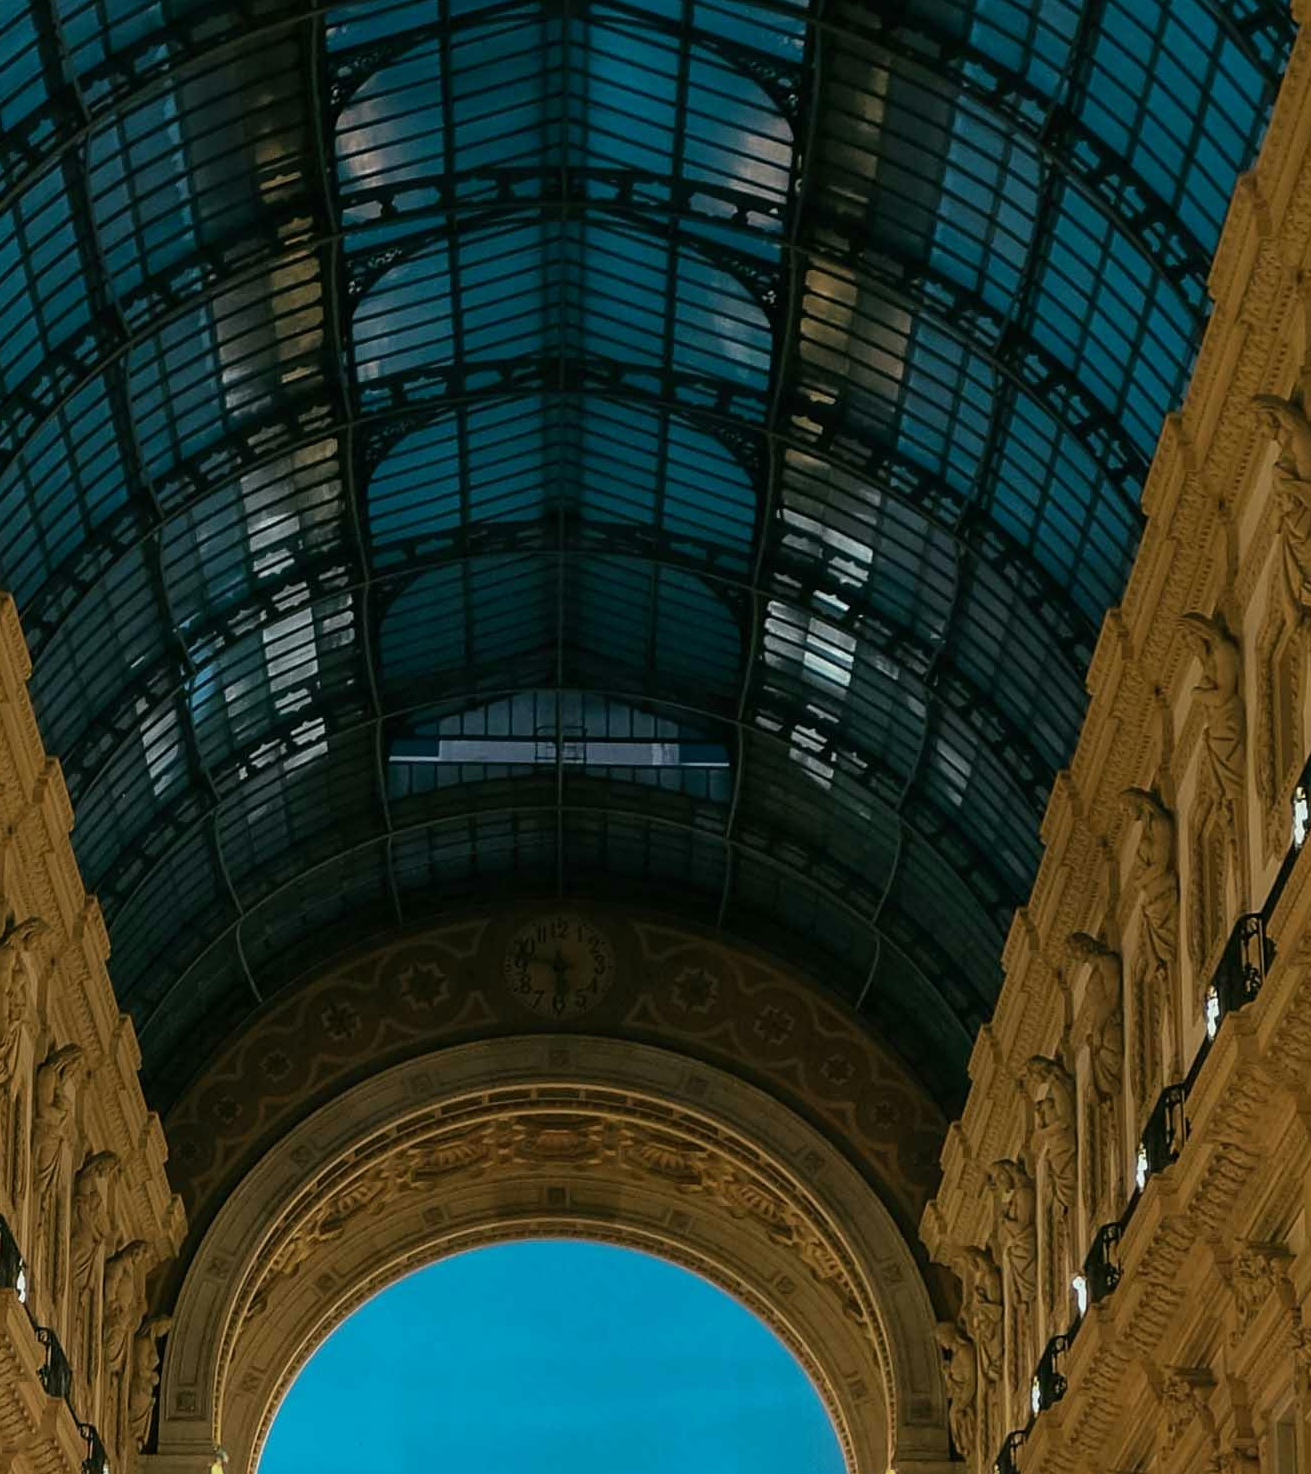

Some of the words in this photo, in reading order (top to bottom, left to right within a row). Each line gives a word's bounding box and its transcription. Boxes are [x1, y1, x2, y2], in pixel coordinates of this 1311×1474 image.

[537, 925, 547, 943] 11
[551, 918, 569, 940] 12
[593, 954, 606, 976] 3
[519, 975, 532, 995] 8
[585, 975, 598, 995] 4
[530, 989, 545, 1009] 7
[574, 989, 588, 1009] 5
